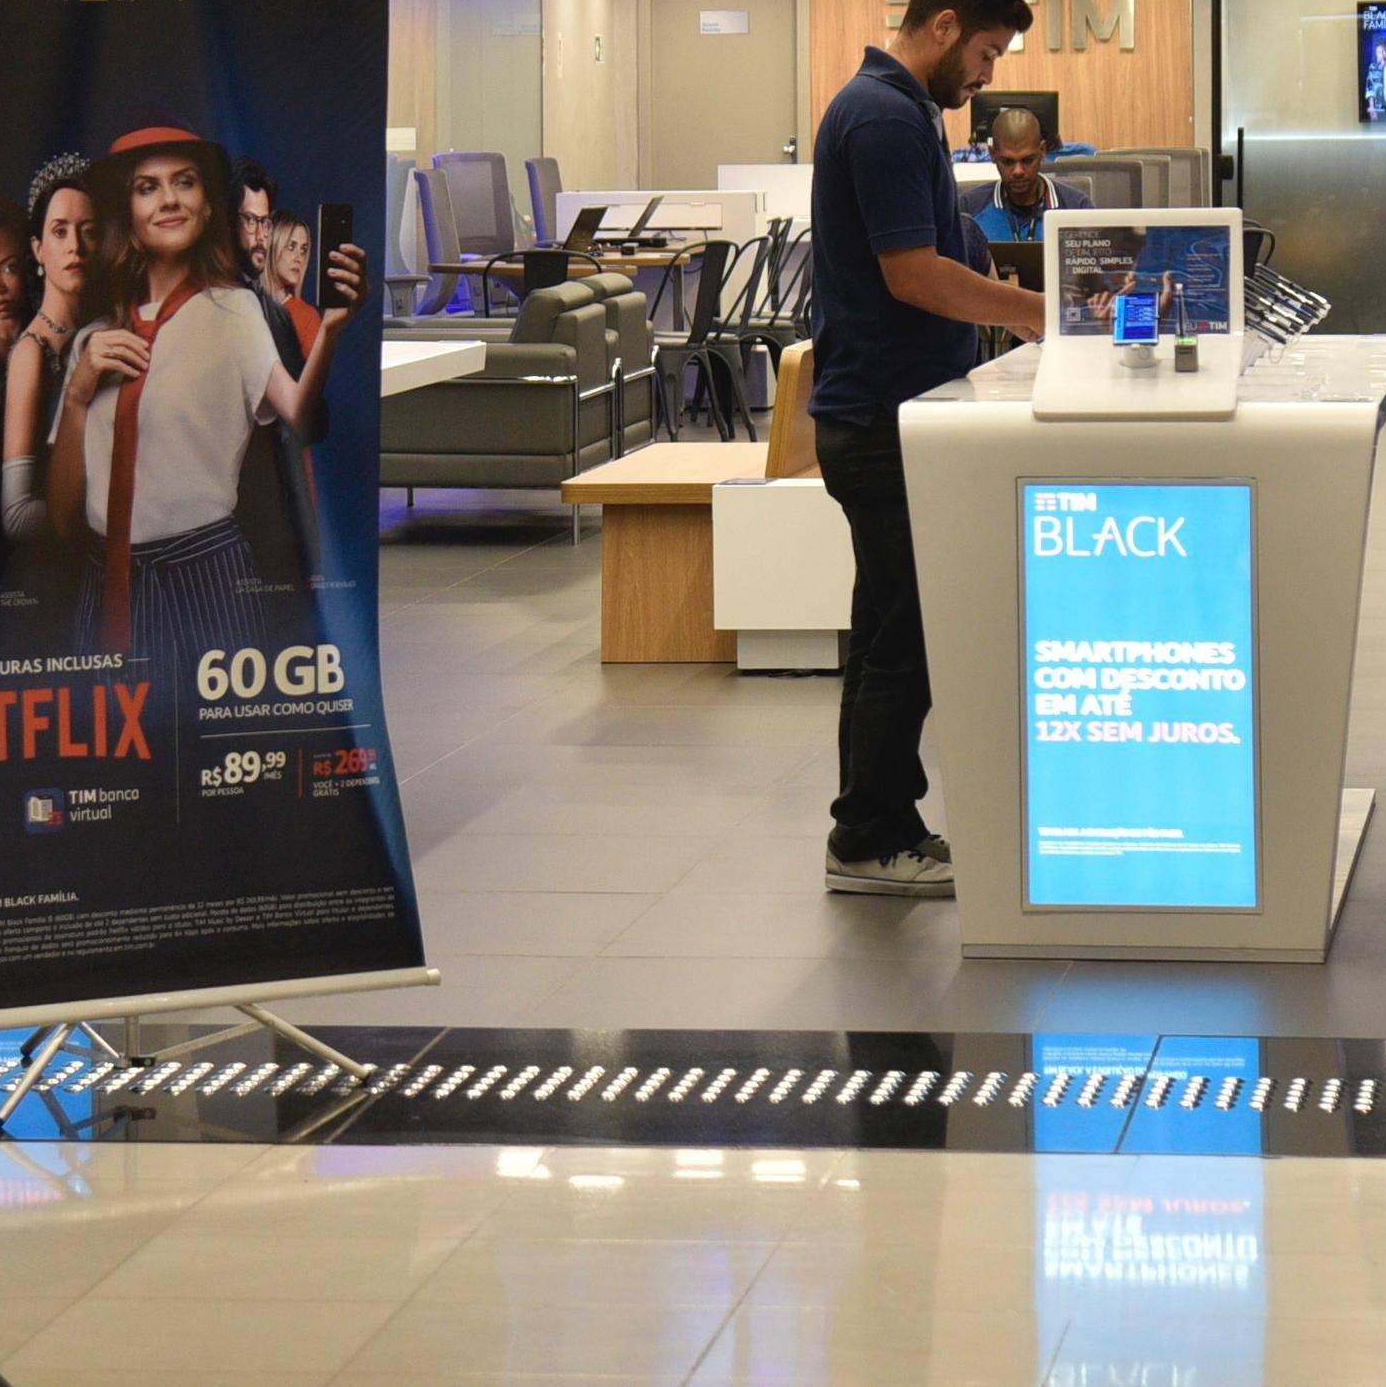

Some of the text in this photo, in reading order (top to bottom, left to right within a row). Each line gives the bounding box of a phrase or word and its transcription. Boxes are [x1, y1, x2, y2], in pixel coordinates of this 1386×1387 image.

[1065, 240, 1081, 248] SEU
[1099, 256, 1133, 264] SIMPLES
[1209, 321, 1227, 330] TIM
[1056, 492, 1096, 511] TIM
[1034, 515, 1187, 557] BLACK
[1035, 641, 1235, 664] SMARTPHONES
[46, 653, 123, 672] INCLUSAS
[196, 644, 345, 701] 60 GB
[1035, 668, 1245, 691] COM DESCONTO
[199, 699, 354, 720] PARA USAR COMO QUISER
[1035, 689, 1132, 716] EM ATÉ
[1036, 721, 1240, 744] 12X SEM JUROS.
[314, 760, 332, 777] R$
[69, 787, 139, 805] TIM banca
[202, 787, 244, 797] POR PESSOA
[70, 805, 112, 822] virtual
[4, 895, 36, 908] BLACK
